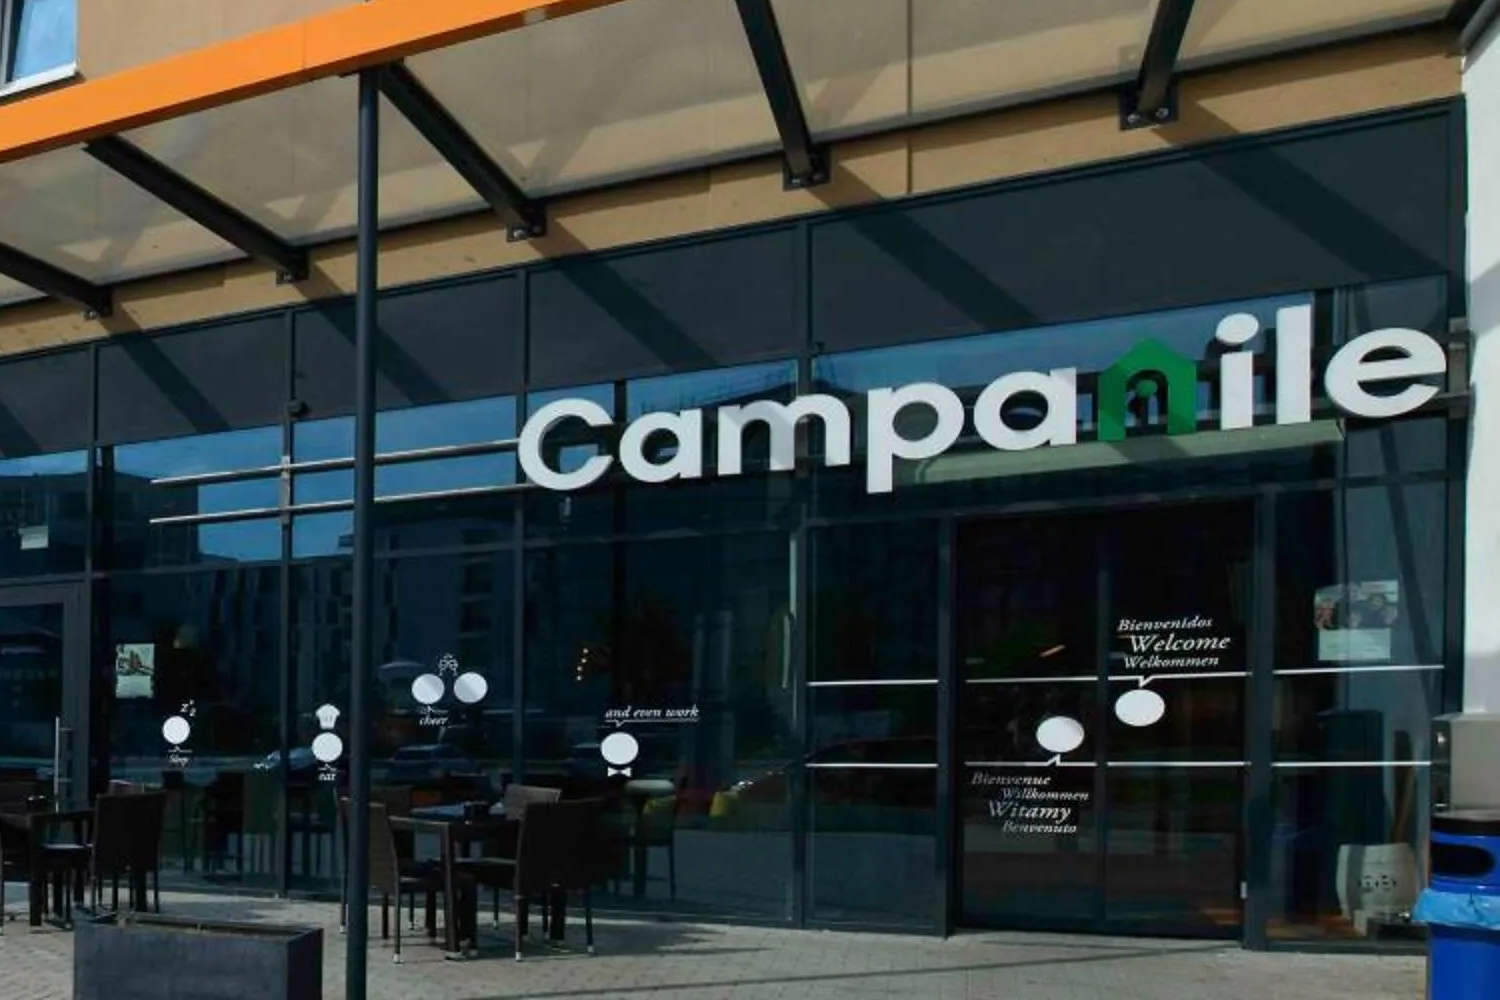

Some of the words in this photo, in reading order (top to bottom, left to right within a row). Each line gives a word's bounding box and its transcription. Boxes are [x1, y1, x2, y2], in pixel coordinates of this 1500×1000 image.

[1118, 615, 1213, 631] Bienvenidos
[1130, 633, 1231, 652] Welcome
[605, 705, 632, 718] and
[633, 709, 662, 718] even
[665, 704, 699, 718] work
[972, 772, 1051, 785] Bienvenue
[1002, 787, 1089, 800] Willkommen
[989, 800, 1071, 824] Witamy
[1003, 820, 1077, 833] Benvenuto
